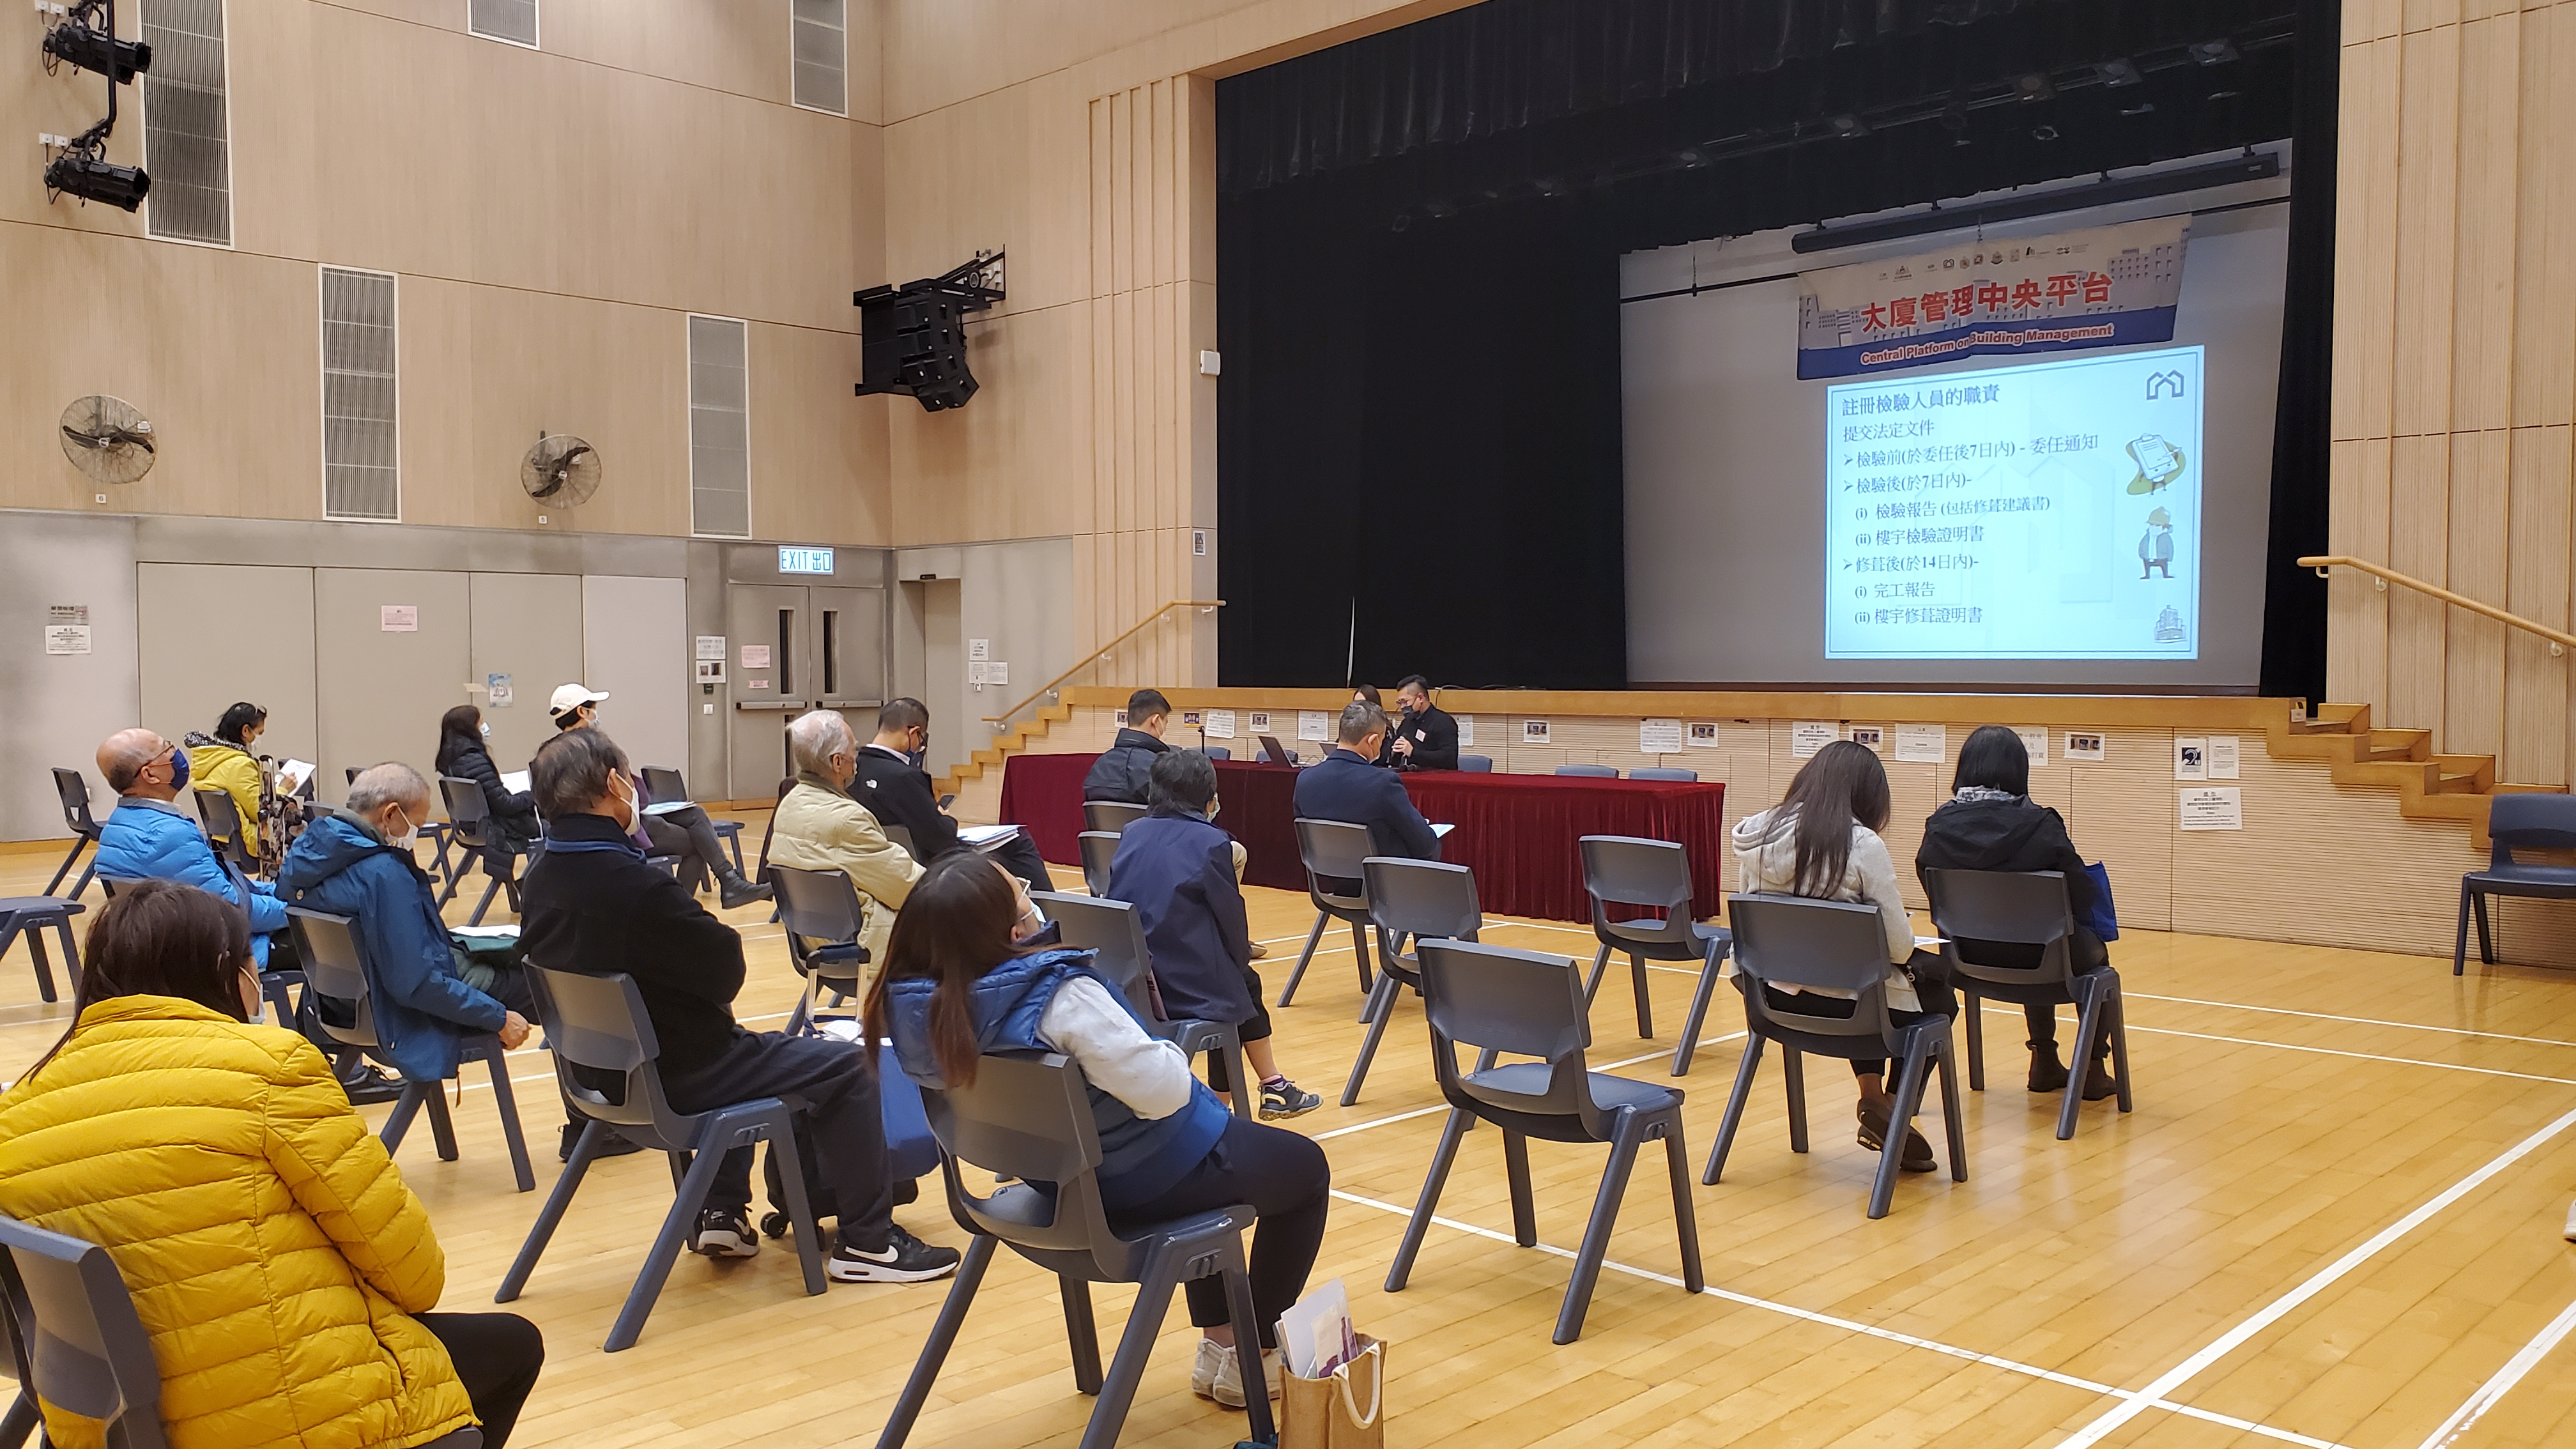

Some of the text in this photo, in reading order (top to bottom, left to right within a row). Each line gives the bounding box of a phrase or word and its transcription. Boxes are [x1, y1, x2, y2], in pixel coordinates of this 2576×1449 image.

[1861, 271, 2113, 333] 大廈管理中央平台
[1862, 325, 2113, 365] Central Platform on Building Management
[1842, 383, 2000, 417] 註冊檢驗人員的職責
[1843, 418, 1935, 443] 提交法定文件
[2030, 433, 2099, 456] 委任通知
[1855, 507, 1867, 521] (i)
[1875, 501, 1937, 520] 檢驗報告
[1855, 525, 1985, 546] (ii) 樓宇檢驗證明書
[781, 551, 831, 571] EXIT 出口
[1855, 581, 1935, 599] (i) 完工報告
[1855, 606, 1983, 625] (ii) 樓宇修葺證明書
